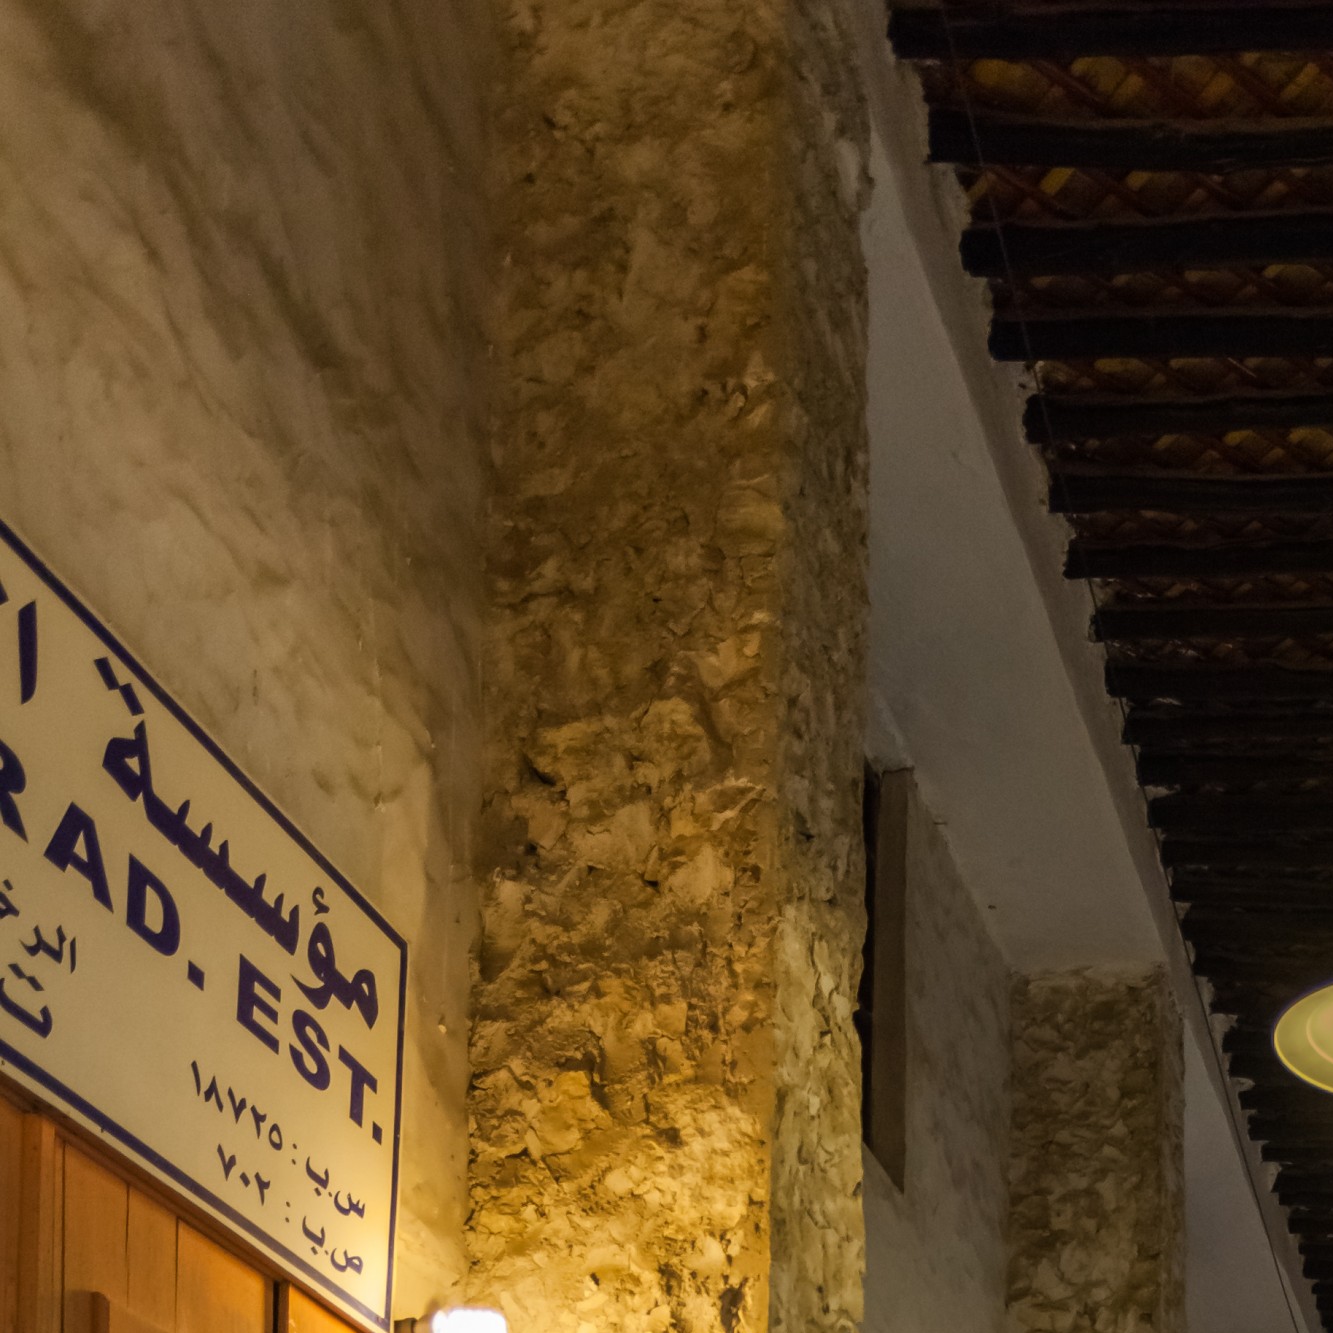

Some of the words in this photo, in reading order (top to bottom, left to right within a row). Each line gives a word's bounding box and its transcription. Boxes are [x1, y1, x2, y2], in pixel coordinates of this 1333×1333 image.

[94, 655, 379, 1030] مؤسسة
[190, 1060, 283, 1152] ١٨٧٢٥
[236, 953, 383, 1146] EST.
